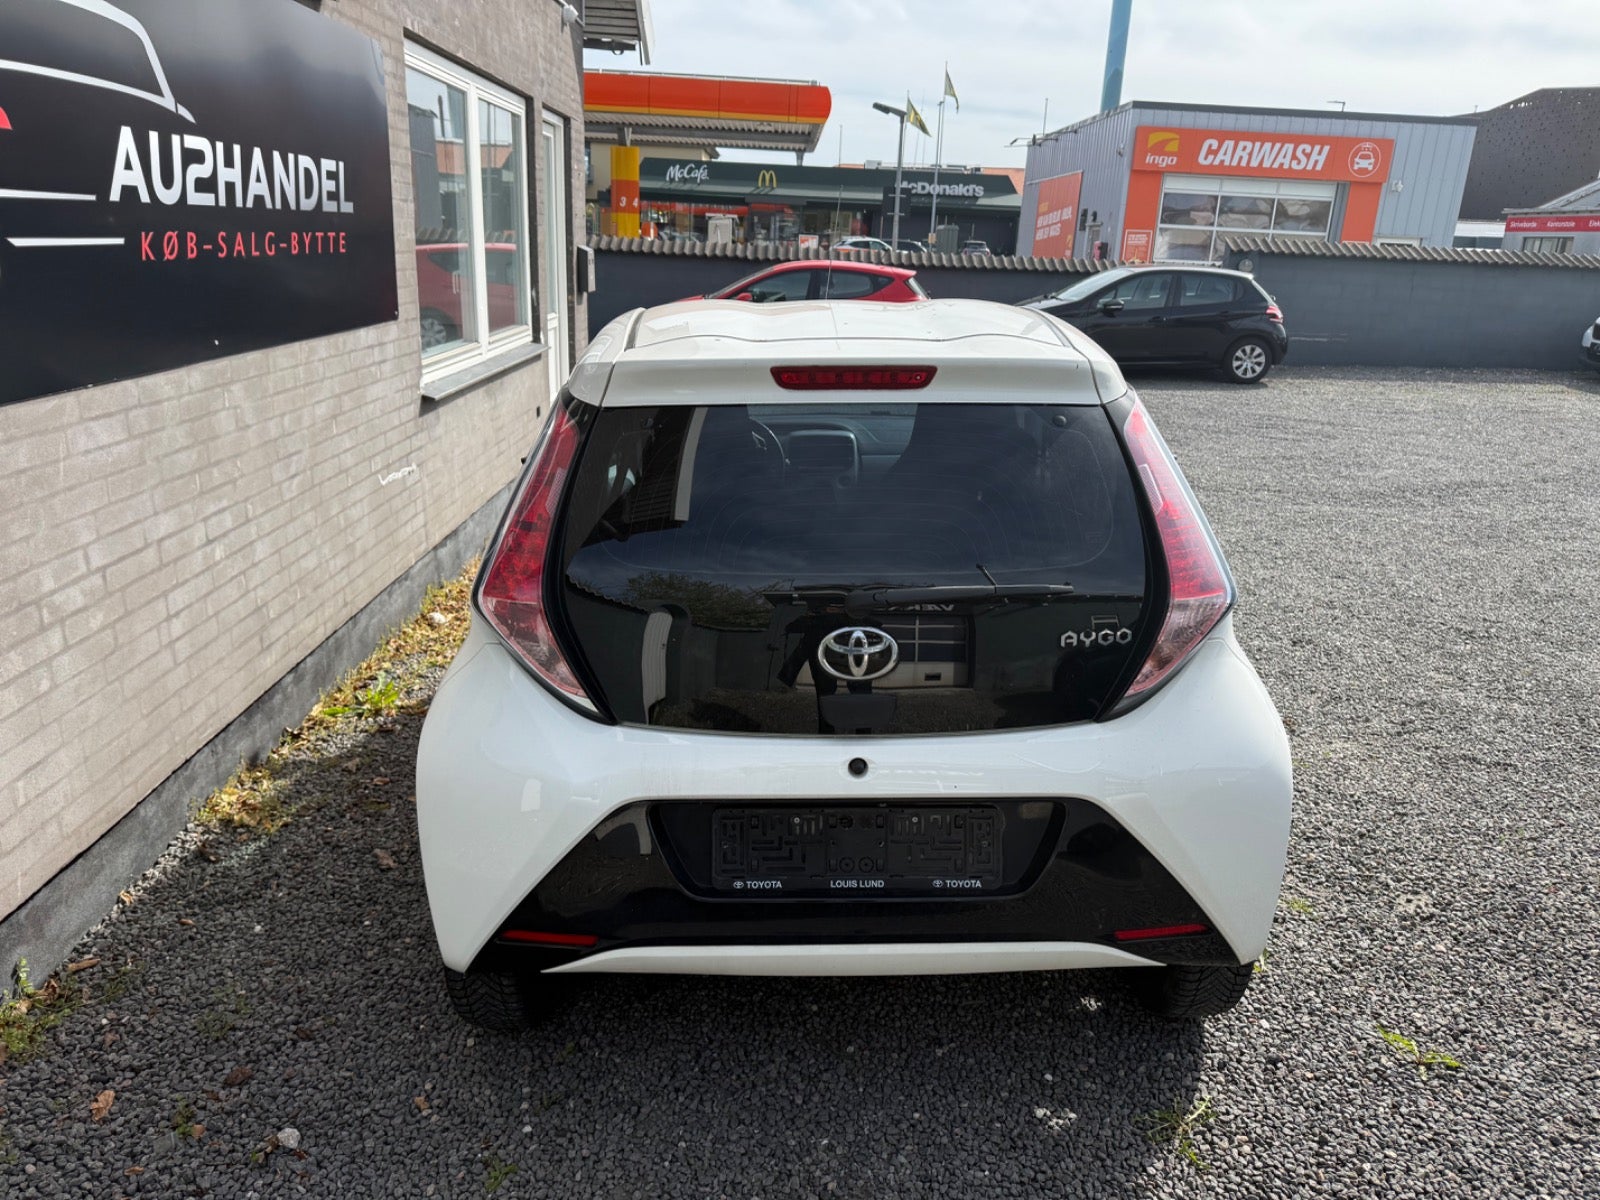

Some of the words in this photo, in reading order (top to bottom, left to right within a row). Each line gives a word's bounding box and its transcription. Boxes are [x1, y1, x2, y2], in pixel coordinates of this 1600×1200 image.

[1145, 153, 1178, 167] ingo
[1198, 138, 1330, 171] CARWASH
[620, 196, 627, 207] 3
[633, 197, 639, 207] 4
[140, 231, 347, 261] KØB-SALG-BYTTE
[1060, 628, 1132, 648] AYGO
[746, 880, 782, 889] TOYOTA
[830, 879, 857, 888] LOUIS
[859, 879, 884, 888] LUND
[945, 879, 982, 888] TOYOTA
